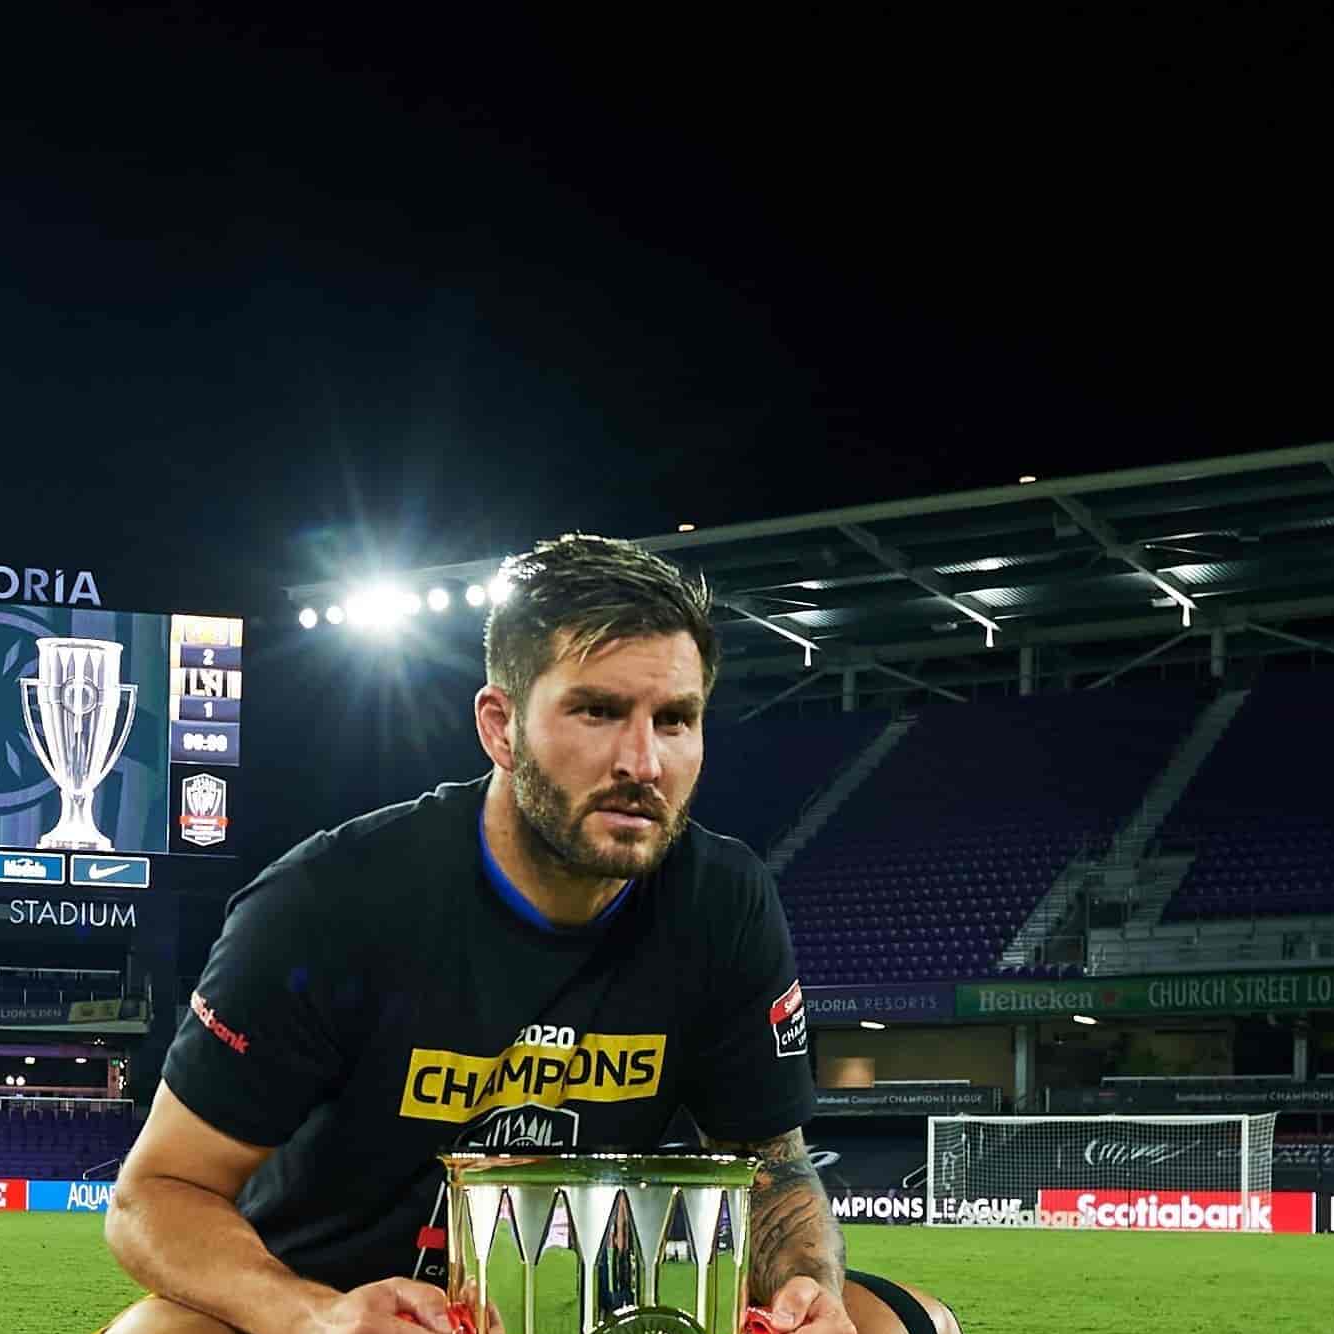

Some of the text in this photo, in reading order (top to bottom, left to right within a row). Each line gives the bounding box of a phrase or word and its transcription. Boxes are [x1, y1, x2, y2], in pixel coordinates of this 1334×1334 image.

[203, 649, 214, 665] 2
[203, 702, 213, 718] 1
[9, 900, 137, 927] STADIUM
[978, 988, 1094, 1012] Heineken
[1147, 978, 1227, 1008] CHURCH
[1232, 975, 1300, 1005] STREET
[806, 996, 938, 1013] PLORIA RESORTS
[515, 1024, 575, 1048] 2020
[413, 1049, 657, 1108] CHAMPONS
[831, 1196, 924, 1219] MPIONS
[1077, 1194, 1271, 1229] Scotiabank
